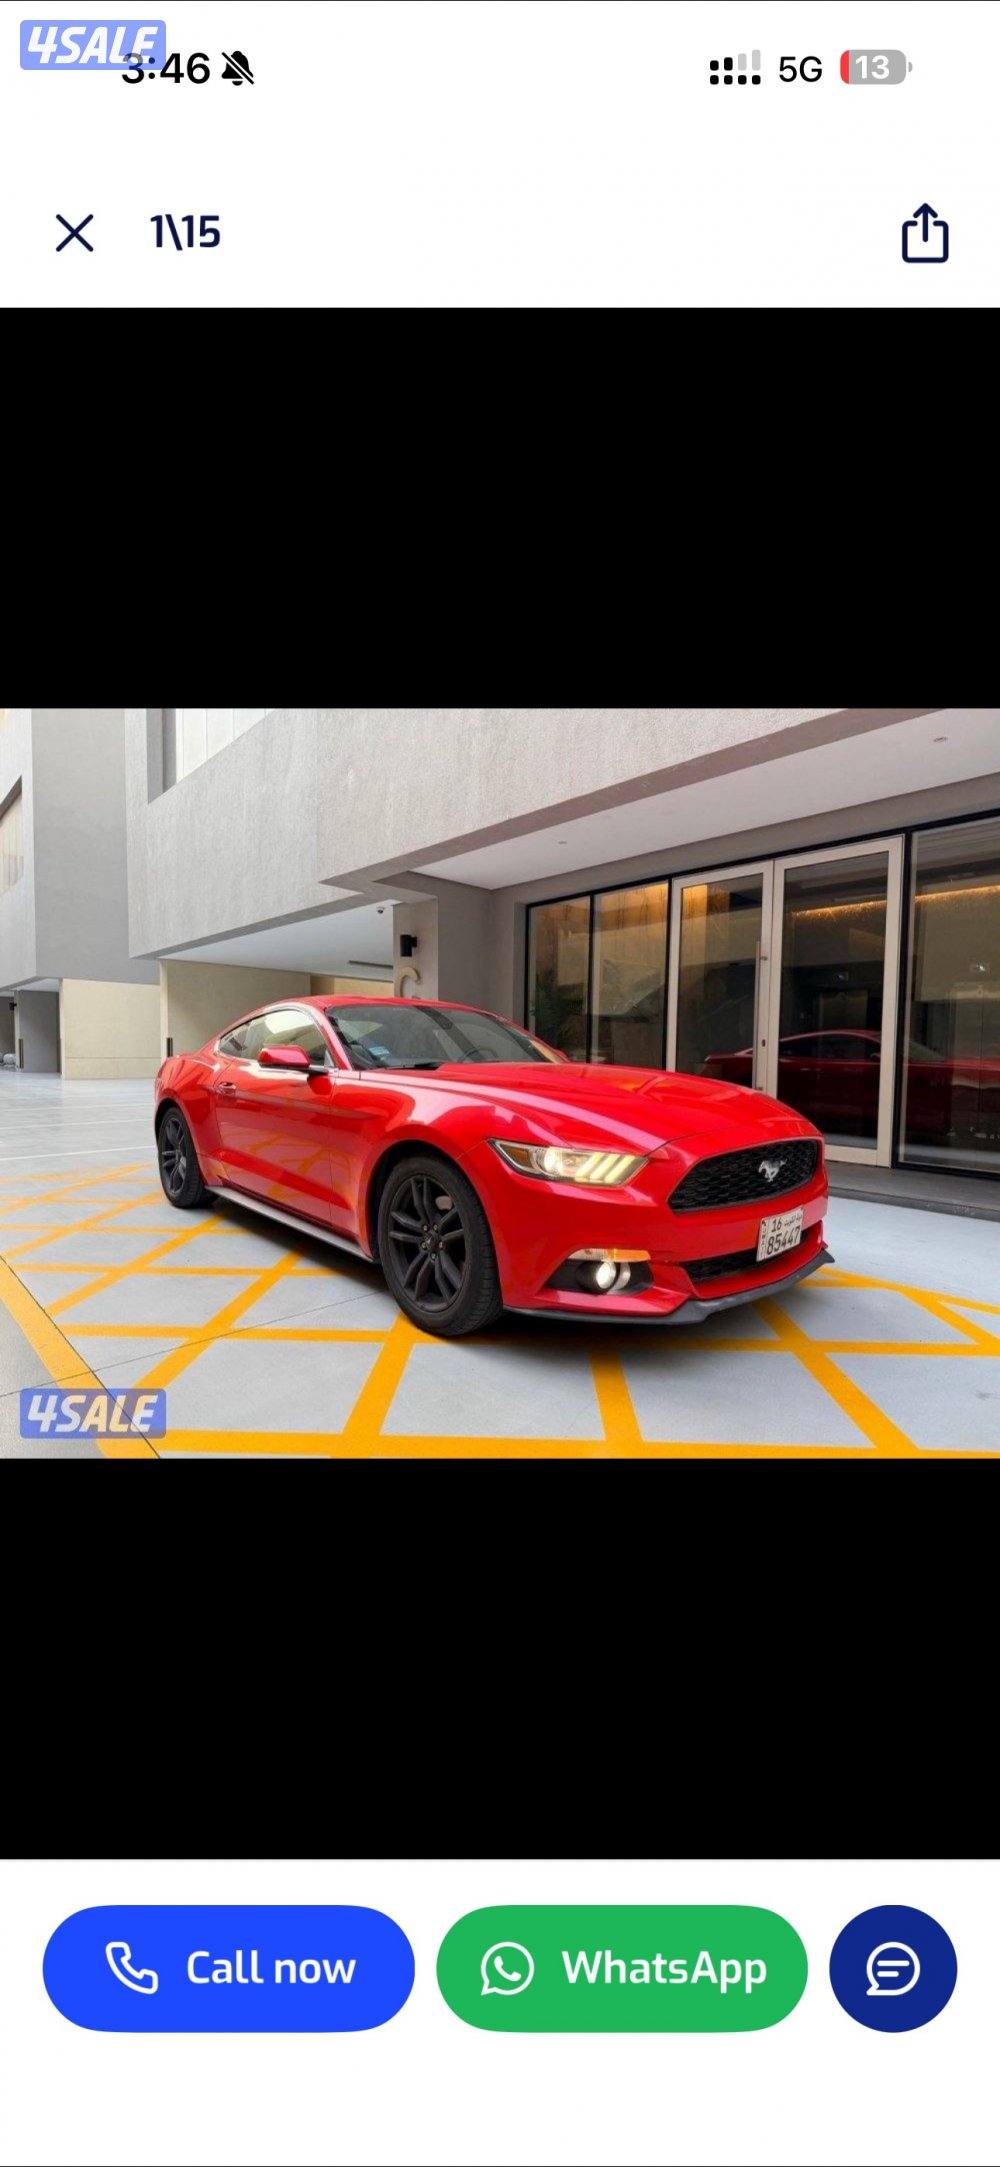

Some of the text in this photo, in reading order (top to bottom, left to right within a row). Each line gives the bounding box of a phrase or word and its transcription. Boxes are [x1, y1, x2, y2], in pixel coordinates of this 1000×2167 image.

[121, 52, 211, 84] 3:46
[778, 55, 823, 82] 5G
[855, 55, 890, 79] 13
[151, 214, 221, 251] 1\15
[767, 1225, 801, 1255] 85447
[188, 1951, 356, 1984] Call now
[563, 1951, 767, 1994] WhatsApp
